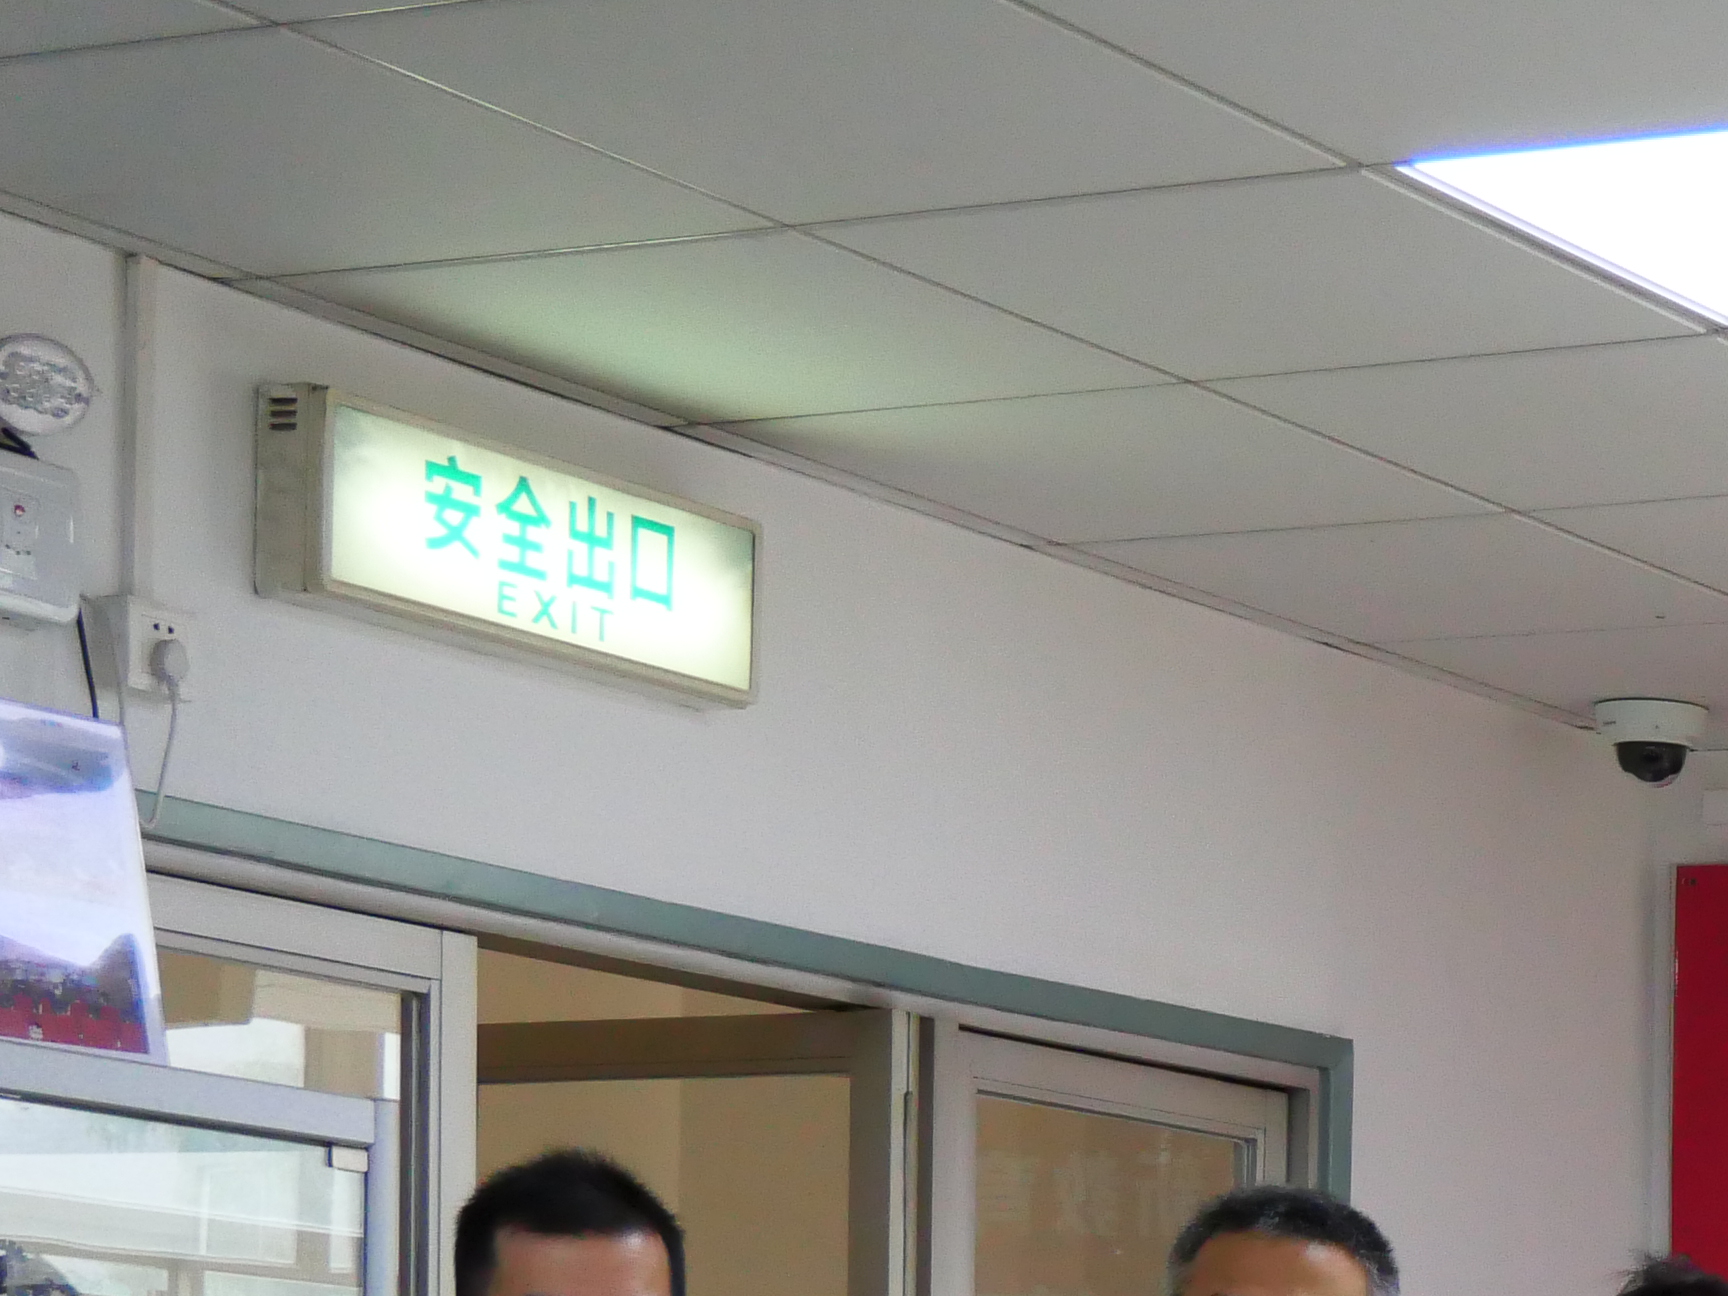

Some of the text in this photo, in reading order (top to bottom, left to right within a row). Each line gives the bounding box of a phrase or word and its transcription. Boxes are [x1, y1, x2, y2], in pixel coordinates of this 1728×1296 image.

[424, 455, 676, 612] 安全出口
[497, 580, 614, 642] EXIT
